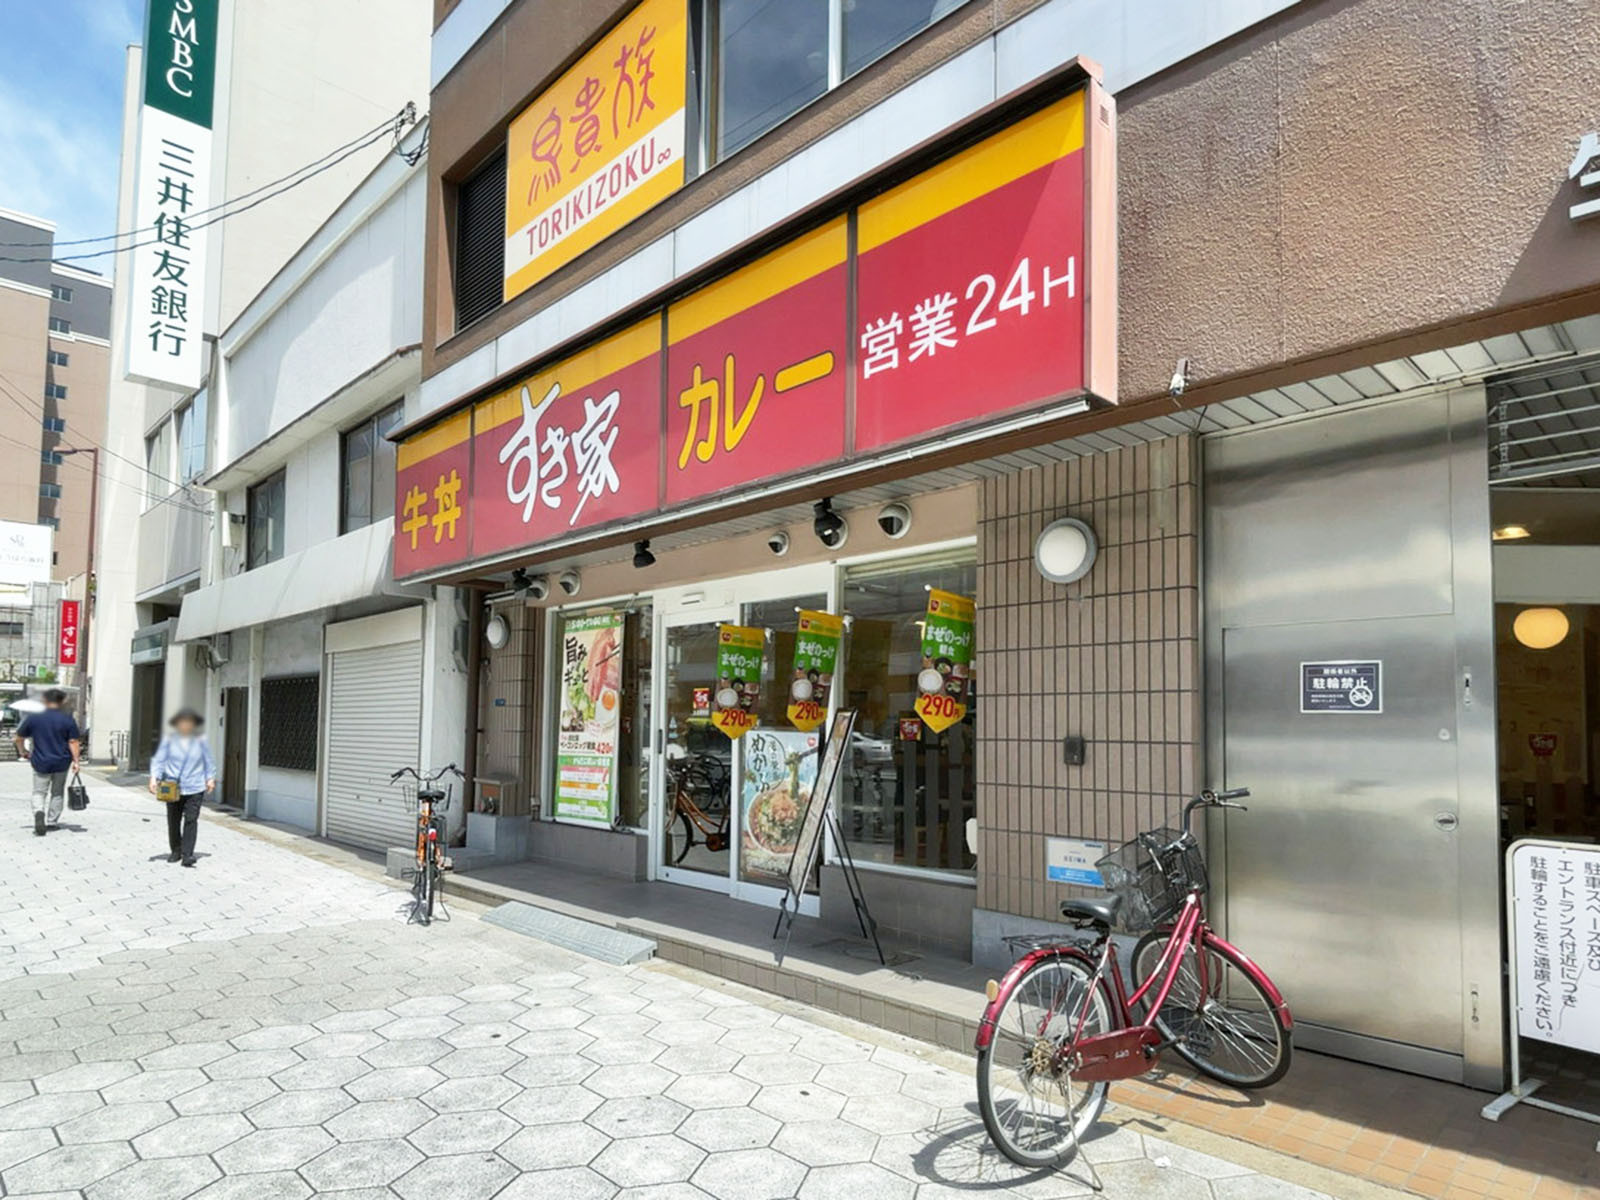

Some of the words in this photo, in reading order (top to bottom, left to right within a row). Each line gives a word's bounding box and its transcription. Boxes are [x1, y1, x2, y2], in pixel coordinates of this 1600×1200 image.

[147, 138, 195, 357] 三井住友銀行
[526, 137, 655, 256] TORIKIZOKU
[499, 382, 621, 526] すき家
[678, 350, 835, 471] カレー
[401, 469, 462, 550] 牛丼
[1312, 677, 1367, 689] 駐輪禁止
[1529, 856, 1553, 1037] 駐輪することをご遠慮ください。
[1557, 859, 1579, 1008] エントランス付近につき
